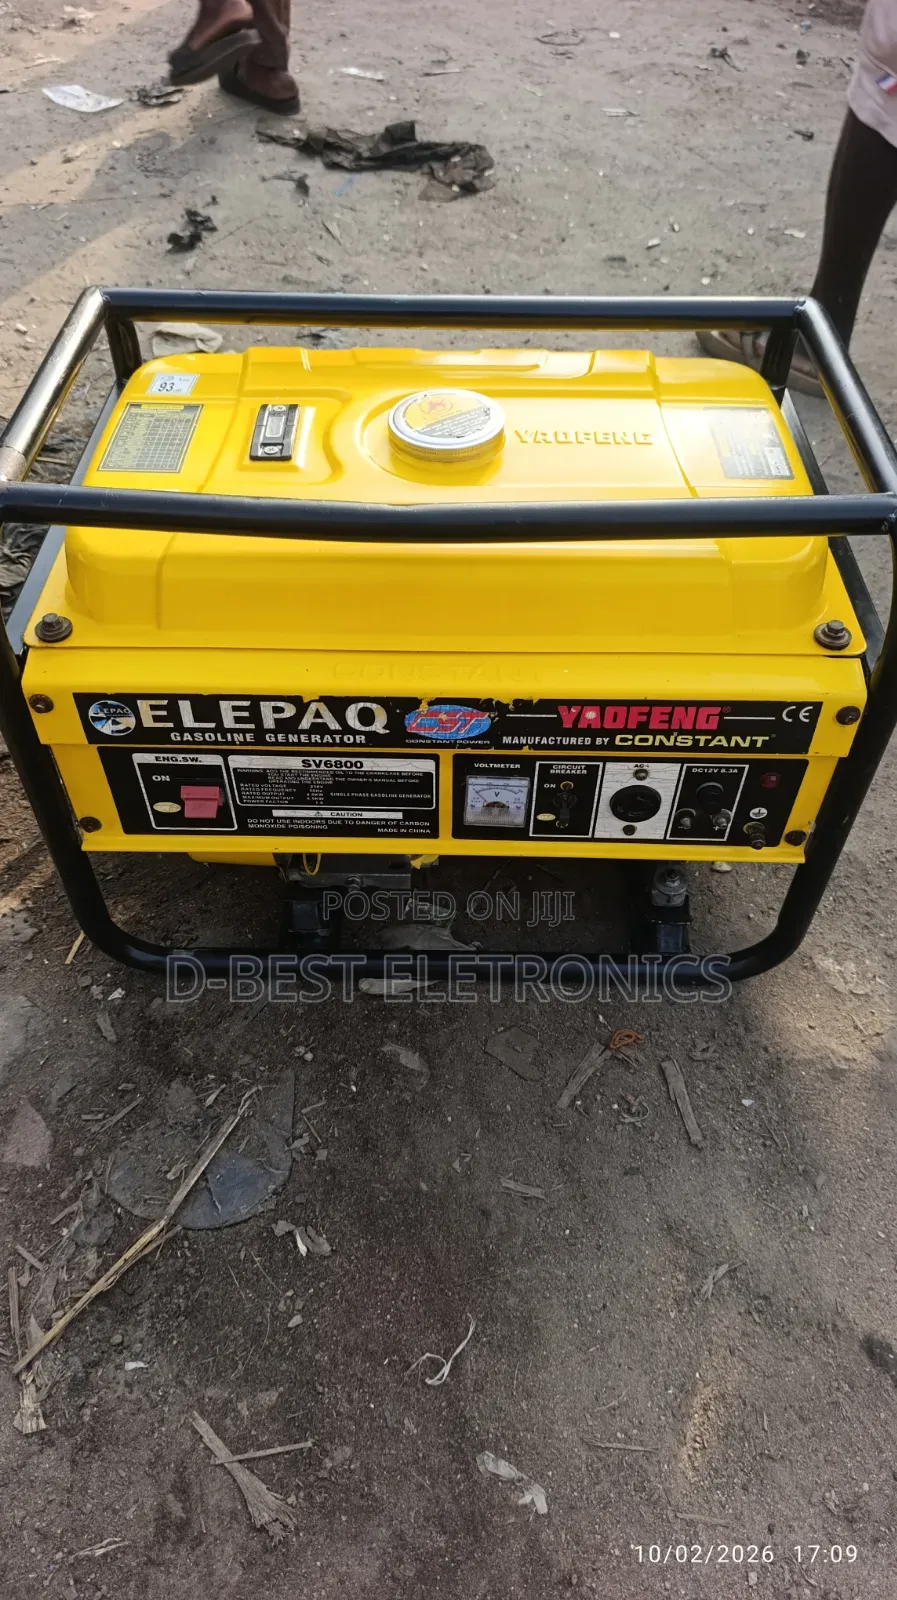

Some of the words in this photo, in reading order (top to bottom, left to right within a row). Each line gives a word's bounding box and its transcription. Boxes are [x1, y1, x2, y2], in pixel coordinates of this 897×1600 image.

[514, 430, 652, 445] YAOFENG
[137, 699, 390, 735] ELEPAQ
[170, 732, 255, 742] GASOLINE
[265, 733, 366, 744] GENERATOR
[502, 736, 591, 745] MANUFACTURED
[595, 737, 610, 746] BY
[615, 734, 769, 748] CONSTANT
[155, 755, 202, 763] ENG.SW.
[301, 759, 364, 769] SV6800
[152, 774, 171, 782] ON
